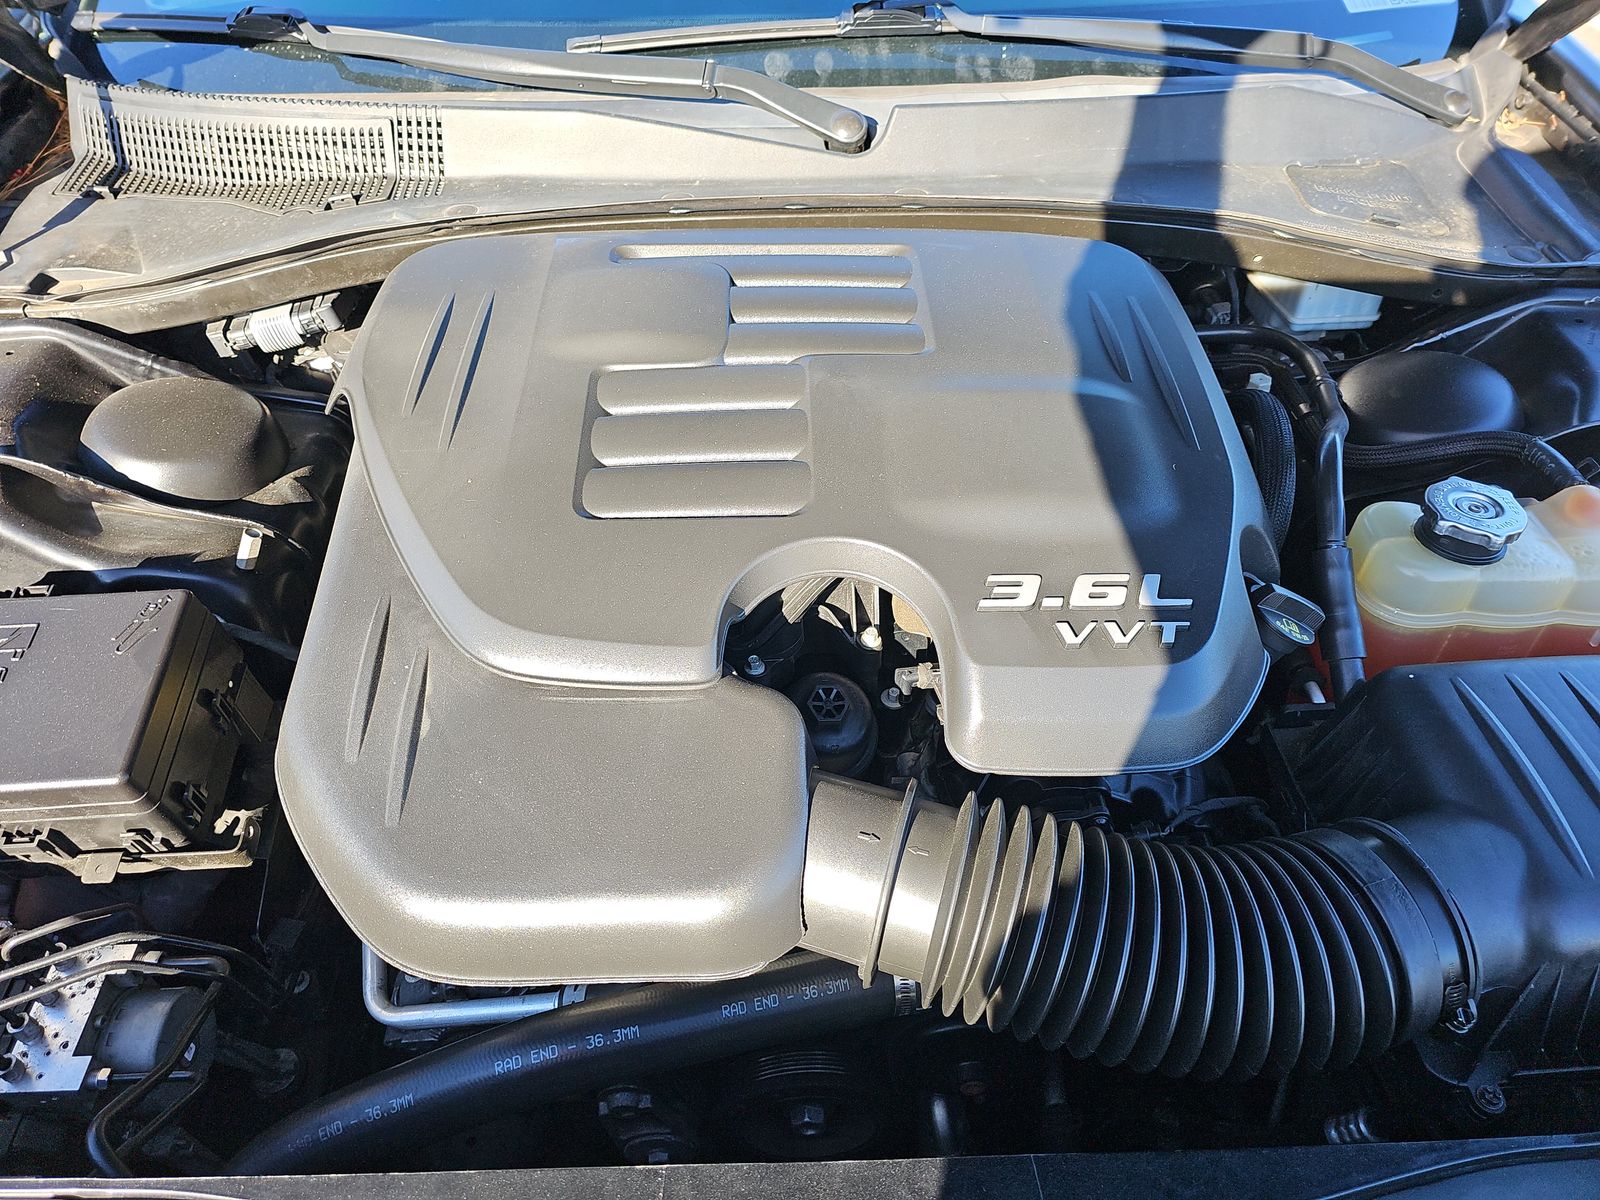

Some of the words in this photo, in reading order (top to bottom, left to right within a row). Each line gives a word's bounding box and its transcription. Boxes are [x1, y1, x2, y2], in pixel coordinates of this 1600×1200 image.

[976, 573, 1193, 612] 3.6L
[1053, 620, 1191, 649] VVT
[721, 1001, 747, 1019] RAD
[754, 993, 780, 1012] END
[802, 977, 850, 1000] 36.3MM
[494, 1054, 522, 1076] RAD
[530, 1044, 559, 1064] END
[586, 1025, 640, 1050] 36.3MM
[318, 1120, 343, 1142] END
[364, 1092, 415, 1123] 36.3MM
